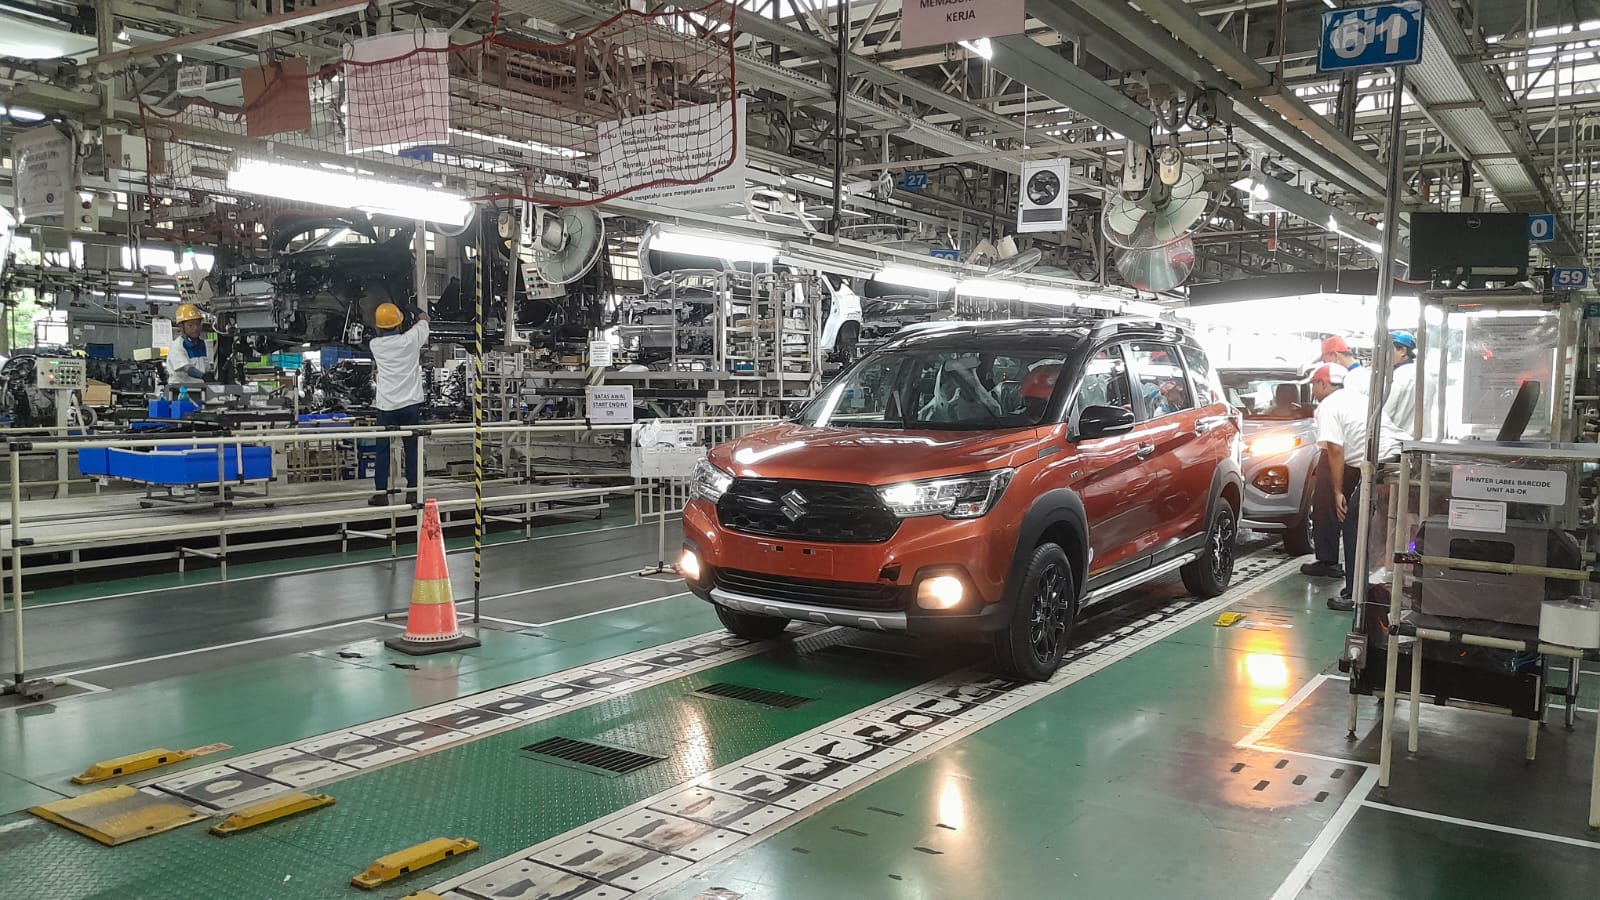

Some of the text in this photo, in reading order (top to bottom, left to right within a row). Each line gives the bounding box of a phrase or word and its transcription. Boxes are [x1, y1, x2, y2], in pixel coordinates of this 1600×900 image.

[946, 9, 976, 22] KERJA
[1330, 14, 1402, 58] 61
[622, 161, 646, 169] Renraku
[691, 150, 712, 160] apabila
[907, 175, 924, 186] 27
[1558, 270, 1584, 284] 59
[1465, 476, 1552, 488] PRINTER LABEL BARCODE
